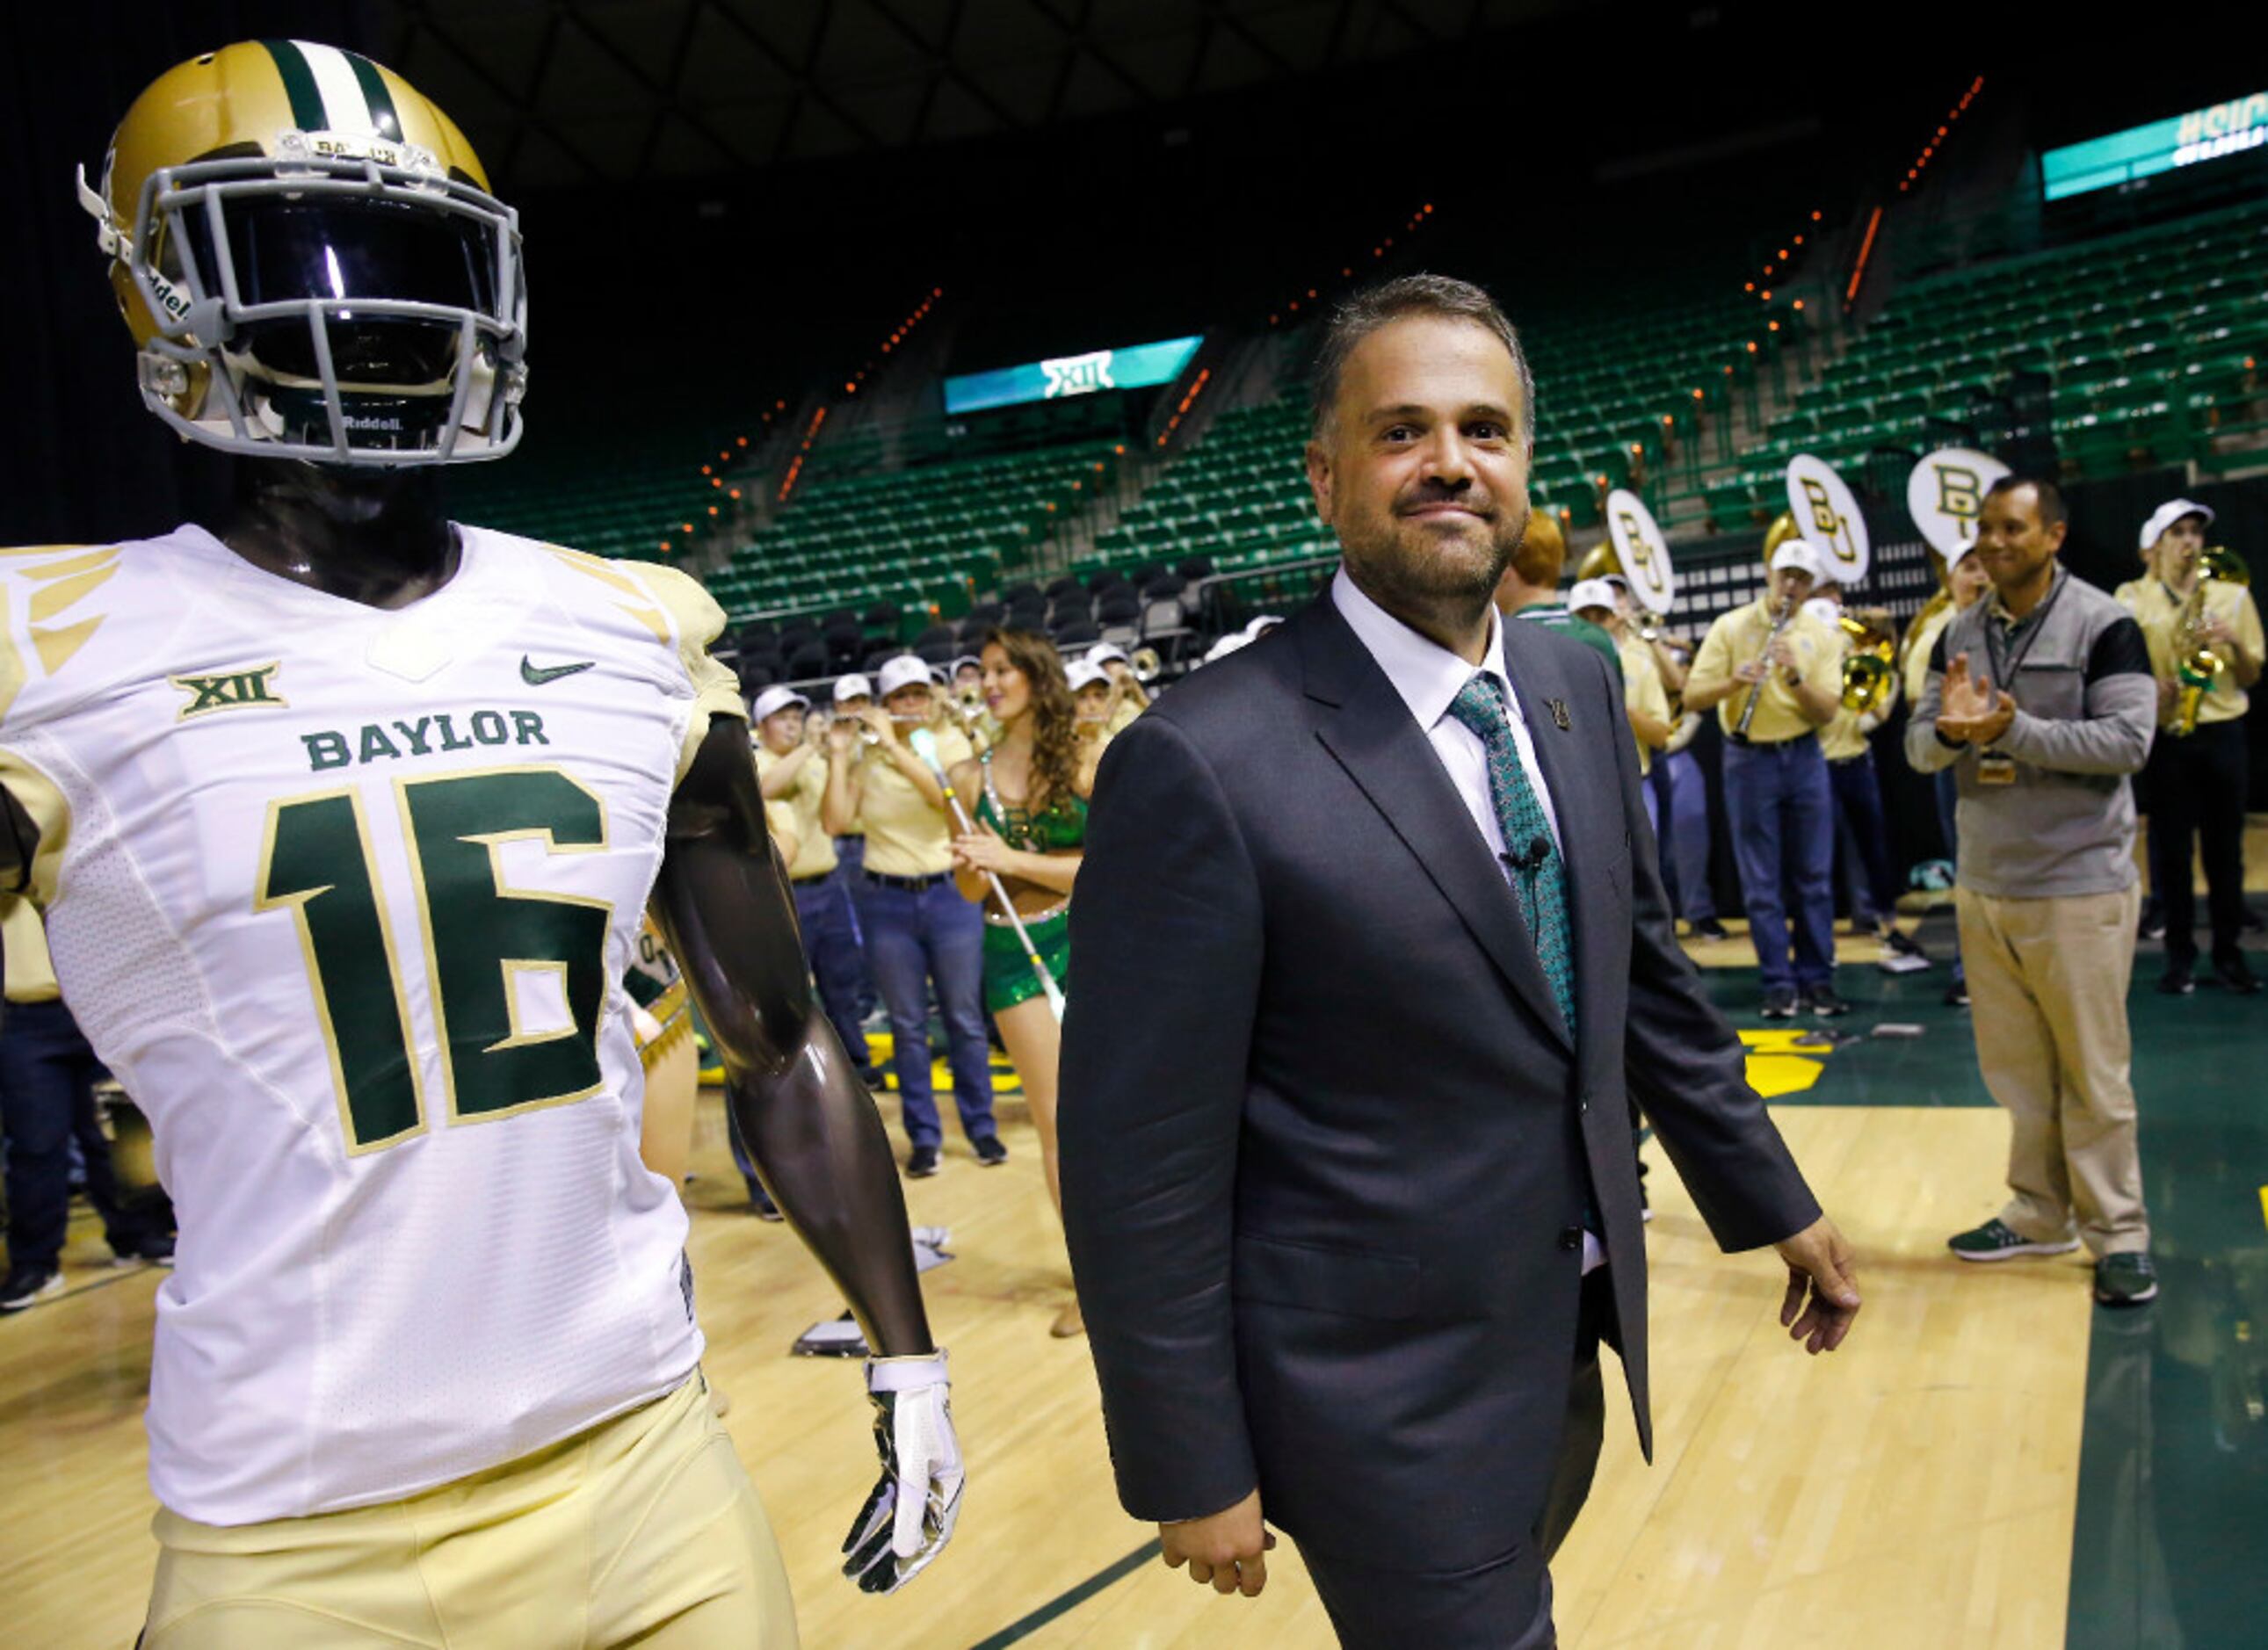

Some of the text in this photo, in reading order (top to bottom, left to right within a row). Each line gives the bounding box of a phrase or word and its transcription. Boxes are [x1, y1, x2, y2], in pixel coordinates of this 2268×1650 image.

[1800, 477, 1856, 562] BU
[173, 664, 285, 718] XII
[301, 710, 549, 771] BAYLOR
[253, 764, 615, 1158] 16
